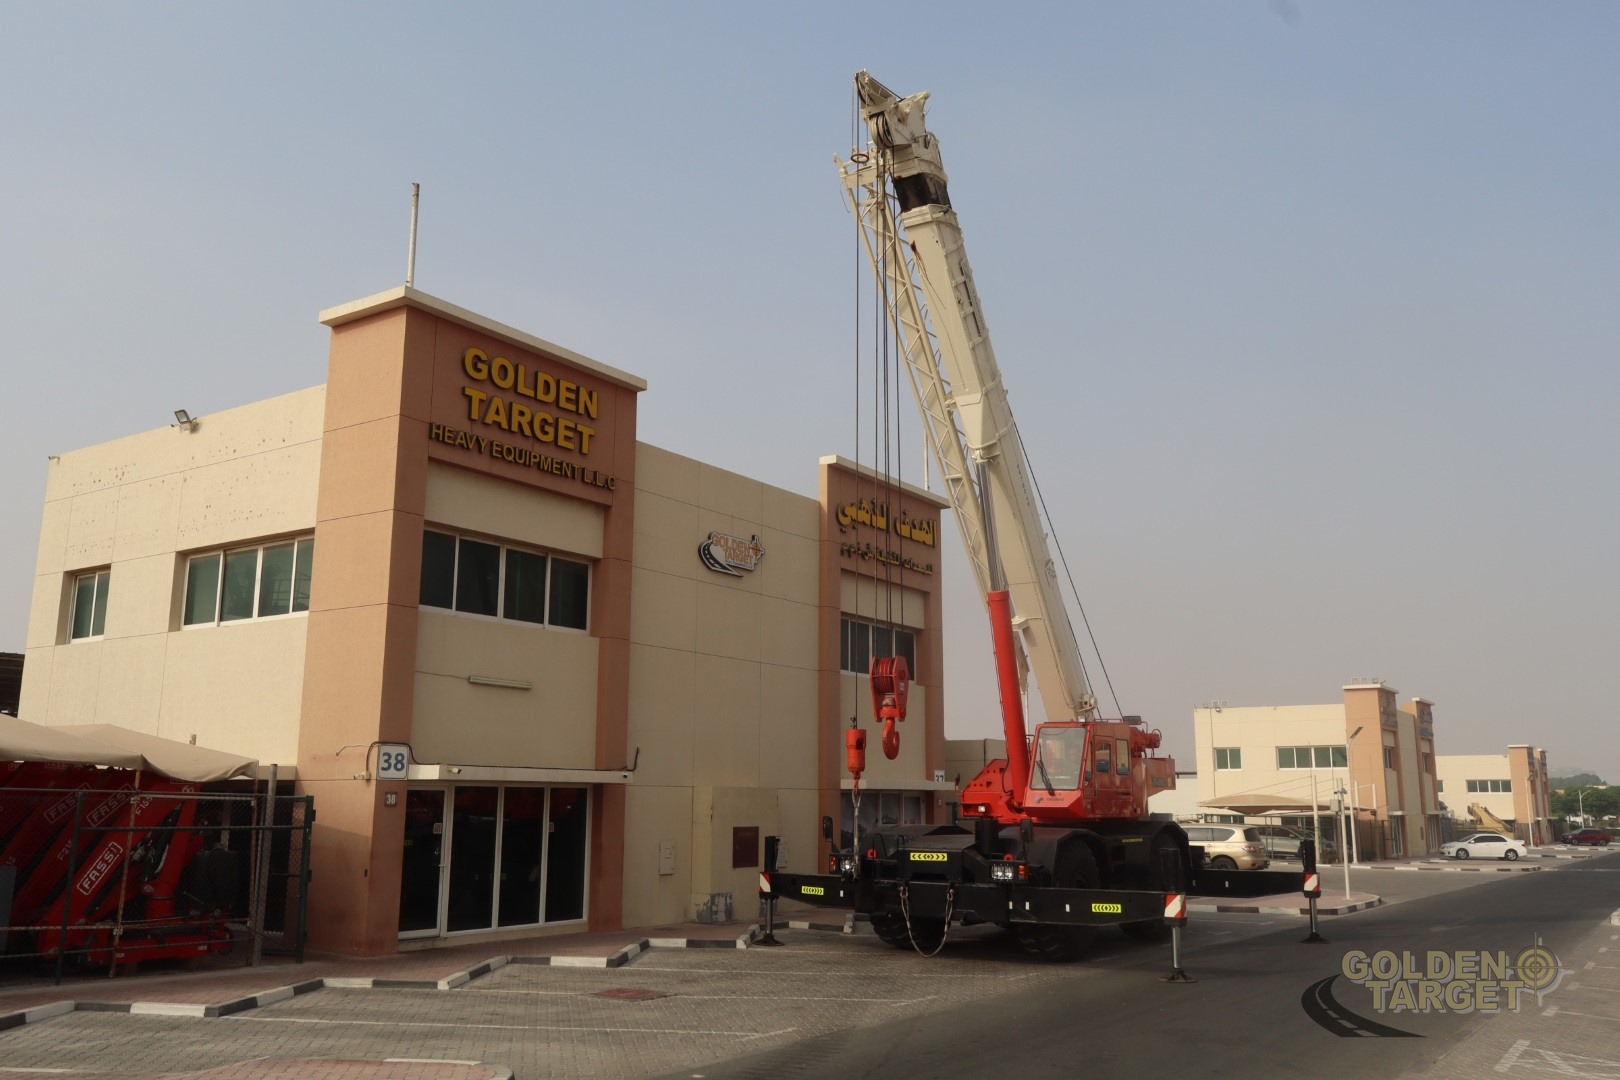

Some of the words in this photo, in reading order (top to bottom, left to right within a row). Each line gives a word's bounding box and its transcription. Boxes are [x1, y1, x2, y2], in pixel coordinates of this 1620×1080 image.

[463, 346, 599, 419] GOLDEN
[462, 386, 597, 455] TARGET
[430, 422, 488, 453] HEAVY
[491, 440, 581, 480] EQUIPMENT
[582, 466, 617, 490] L.L.C
[836, 497, 892, 534] الذهبي
[895, 508, 937, 548] الهدف
[712, 533, 751, 555] GOLDEN
[724, 548, 754, 565] TARGET
[381, 752, 406, 772] 38
[49, 786, 88, 820] FASI
[386, 794, 396, 805] 38
[82, 846, 119, 890] FASSI
